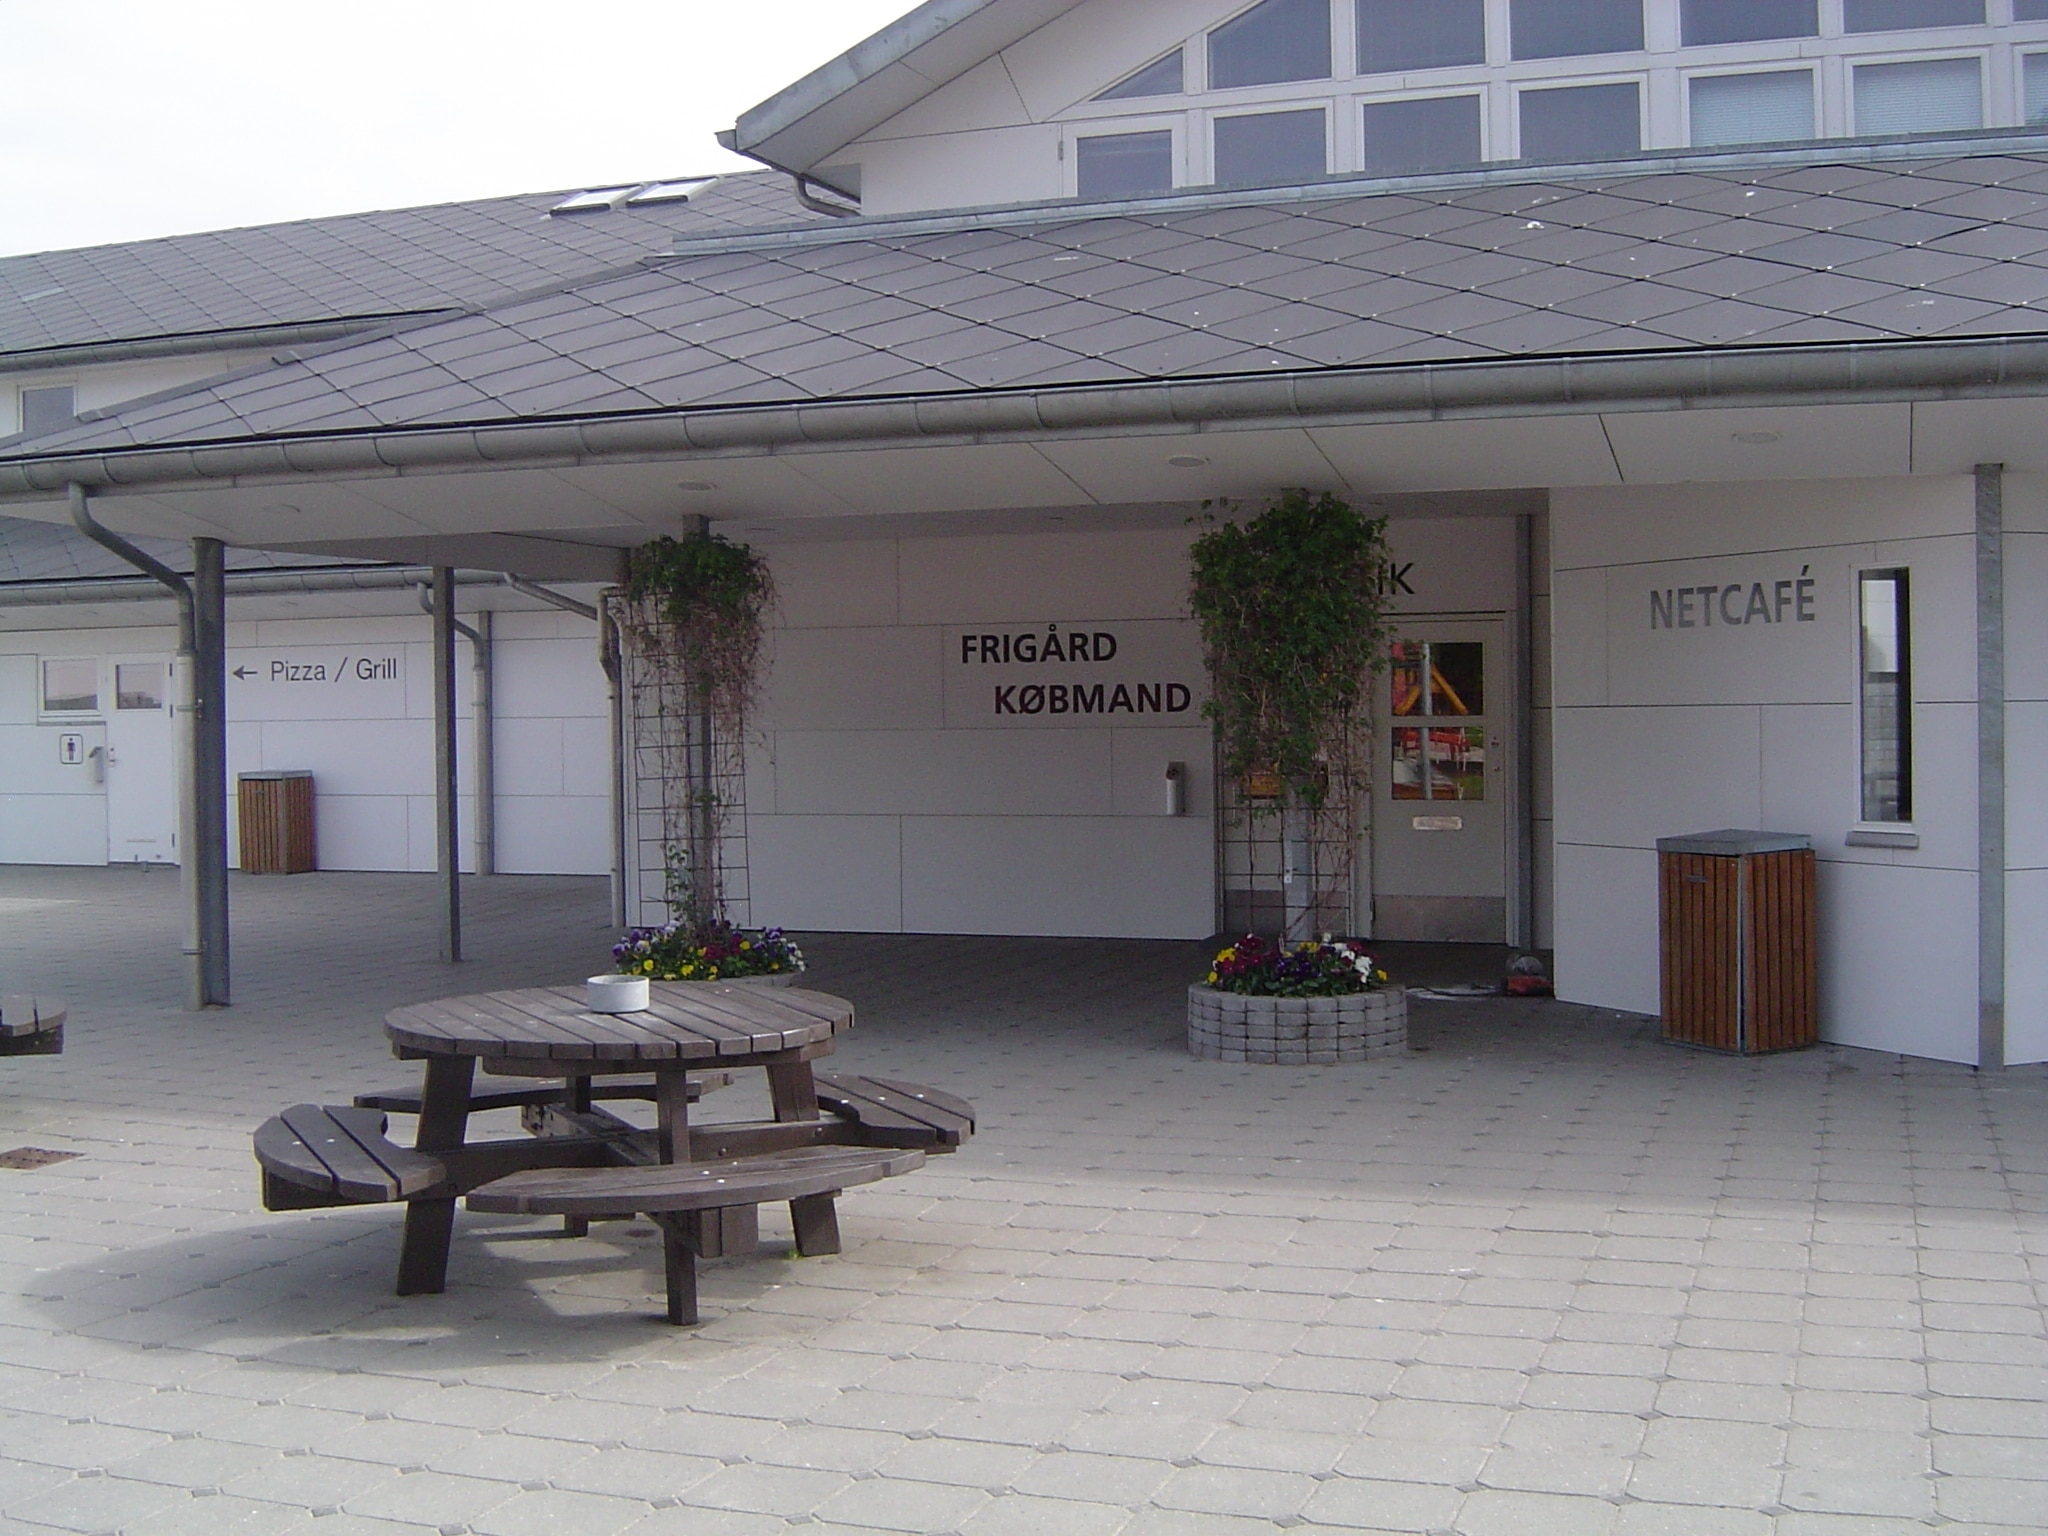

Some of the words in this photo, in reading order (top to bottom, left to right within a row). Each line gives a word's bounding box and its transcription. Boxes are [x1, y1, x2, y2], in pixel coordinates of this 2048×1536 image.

[1650, 564, 1815, 630] NETCAFÉ
[961, 623, 1117, 664] FRIGÅRD
[270, 660, 327, 682] Pizza
[334, 656, 348, 683] /
[356, 657, 397, 680] Grill
[994, 682, 1191, 715] KØBMAND
